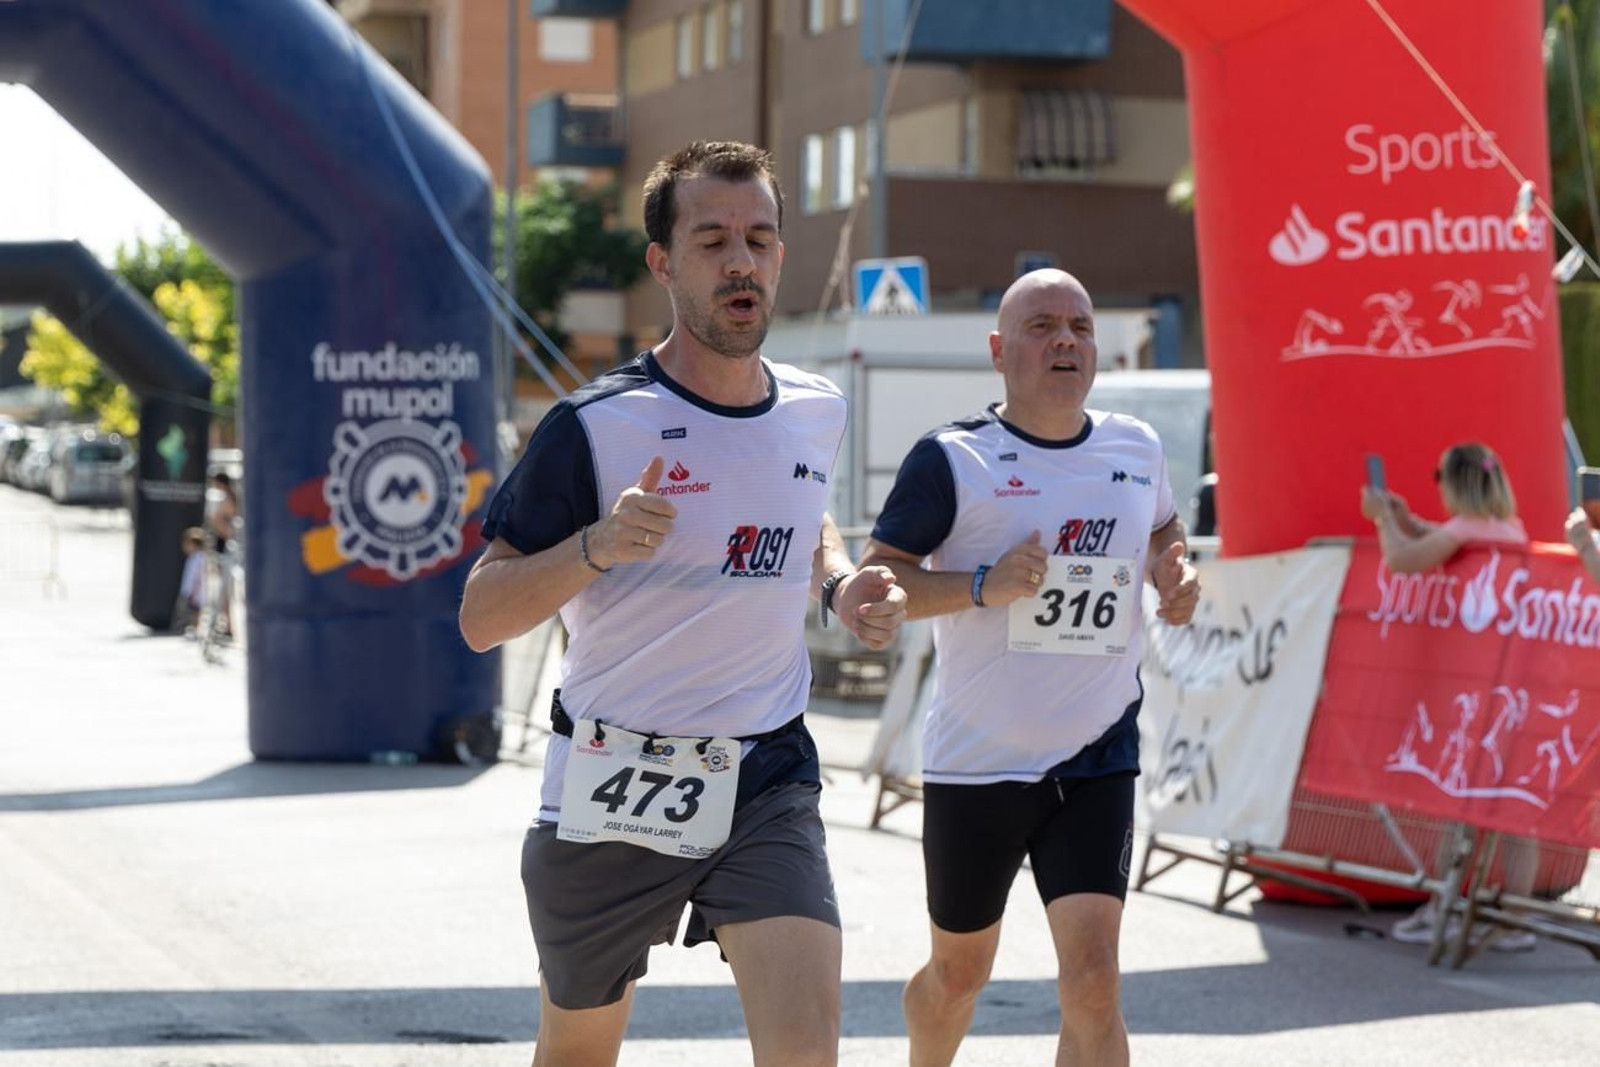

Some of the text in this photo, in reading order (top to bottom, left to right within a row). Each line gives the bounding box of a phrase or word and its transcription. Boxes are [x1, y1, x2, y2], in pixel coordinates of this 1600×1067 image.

[1344, 123, 1499, 185] Sports
[312, 342, 480, 382] fundación
[342, 382, 454, 422] mupol
[656, 482, 711, 496] antander
[994, 487, 1041, 498] Santander
[1034, 588, 1118, 629] 316
[1366, 556, 1457, 639] Sports
[590, 766, 705, 823] 473
[603, 821, 623, 831] JOSE
[654, 828, 683, 839] LARREY
